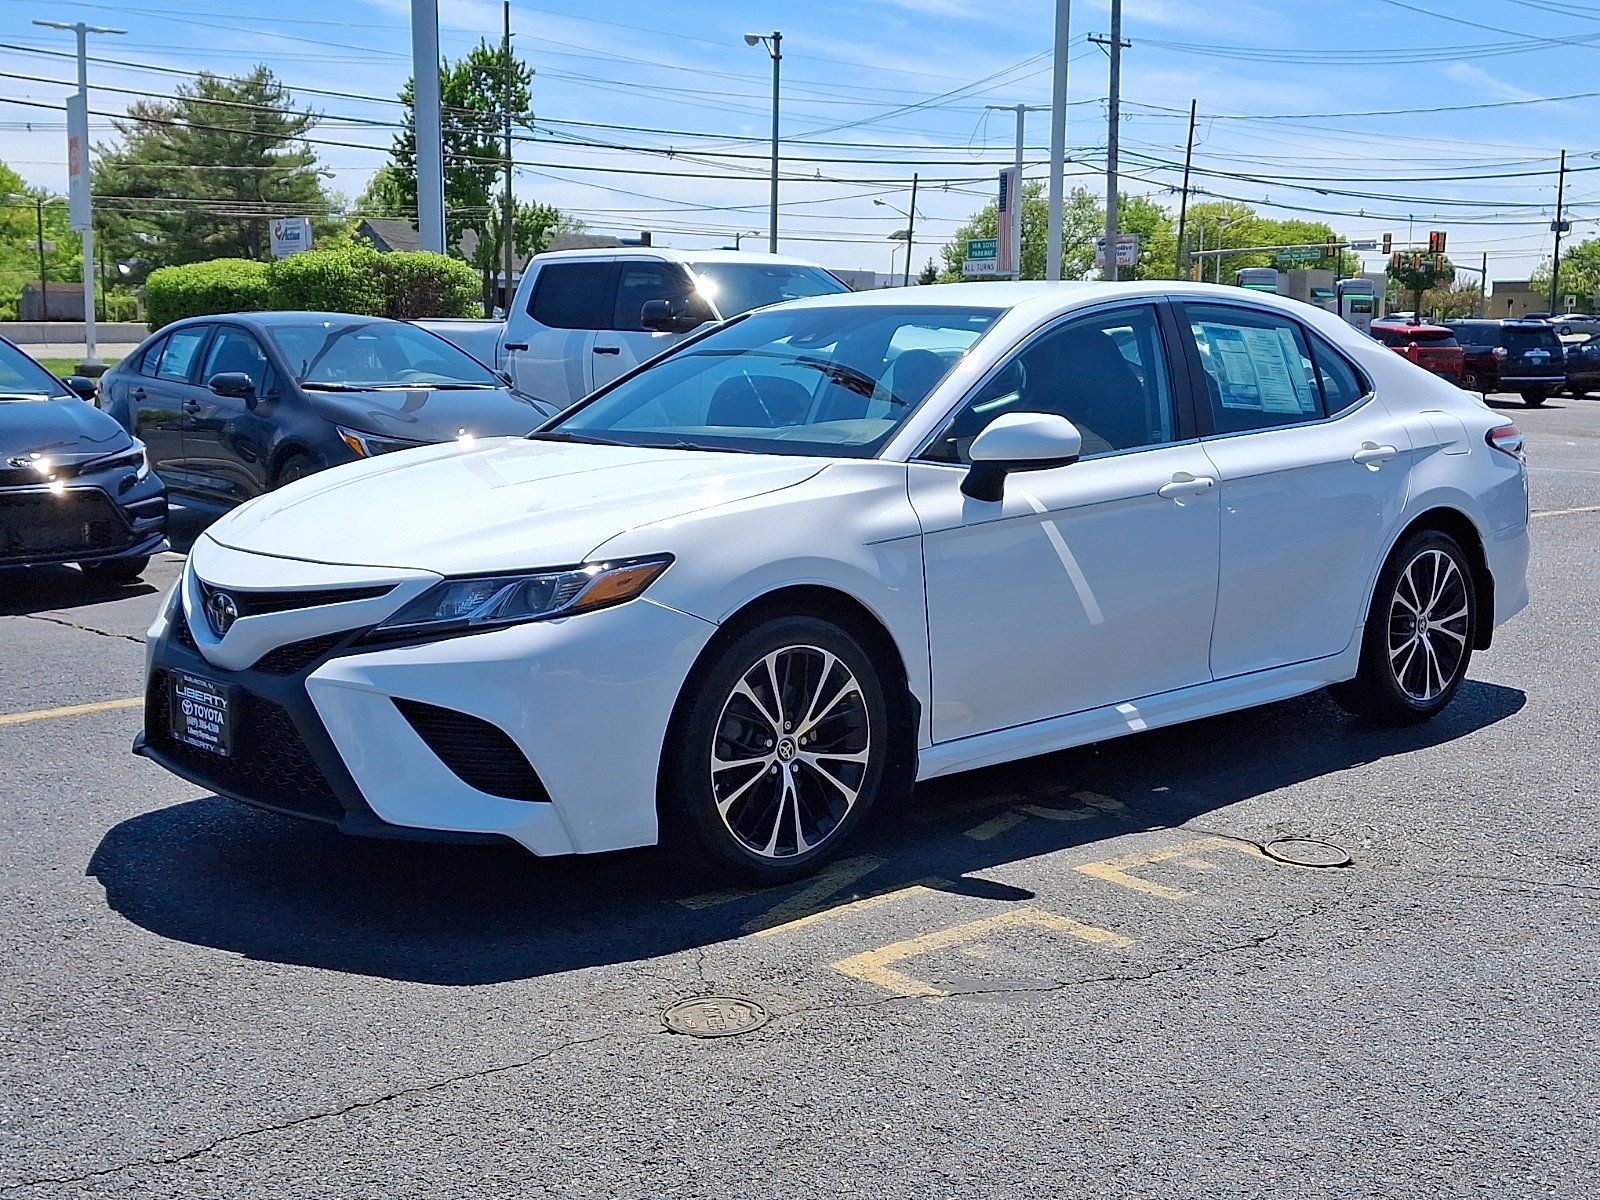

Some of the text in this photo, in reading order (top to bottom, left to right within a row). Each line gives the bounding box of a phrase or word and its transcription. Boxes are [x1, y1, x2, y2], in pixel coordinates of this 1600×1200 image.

[964, 263, 995, 272] ALL TURNS
[175, 684, 228, 709] LIBERTY
[193, 703, 224, 725] TOYOTA
[183, 736, 215, 751] LIBERTY
